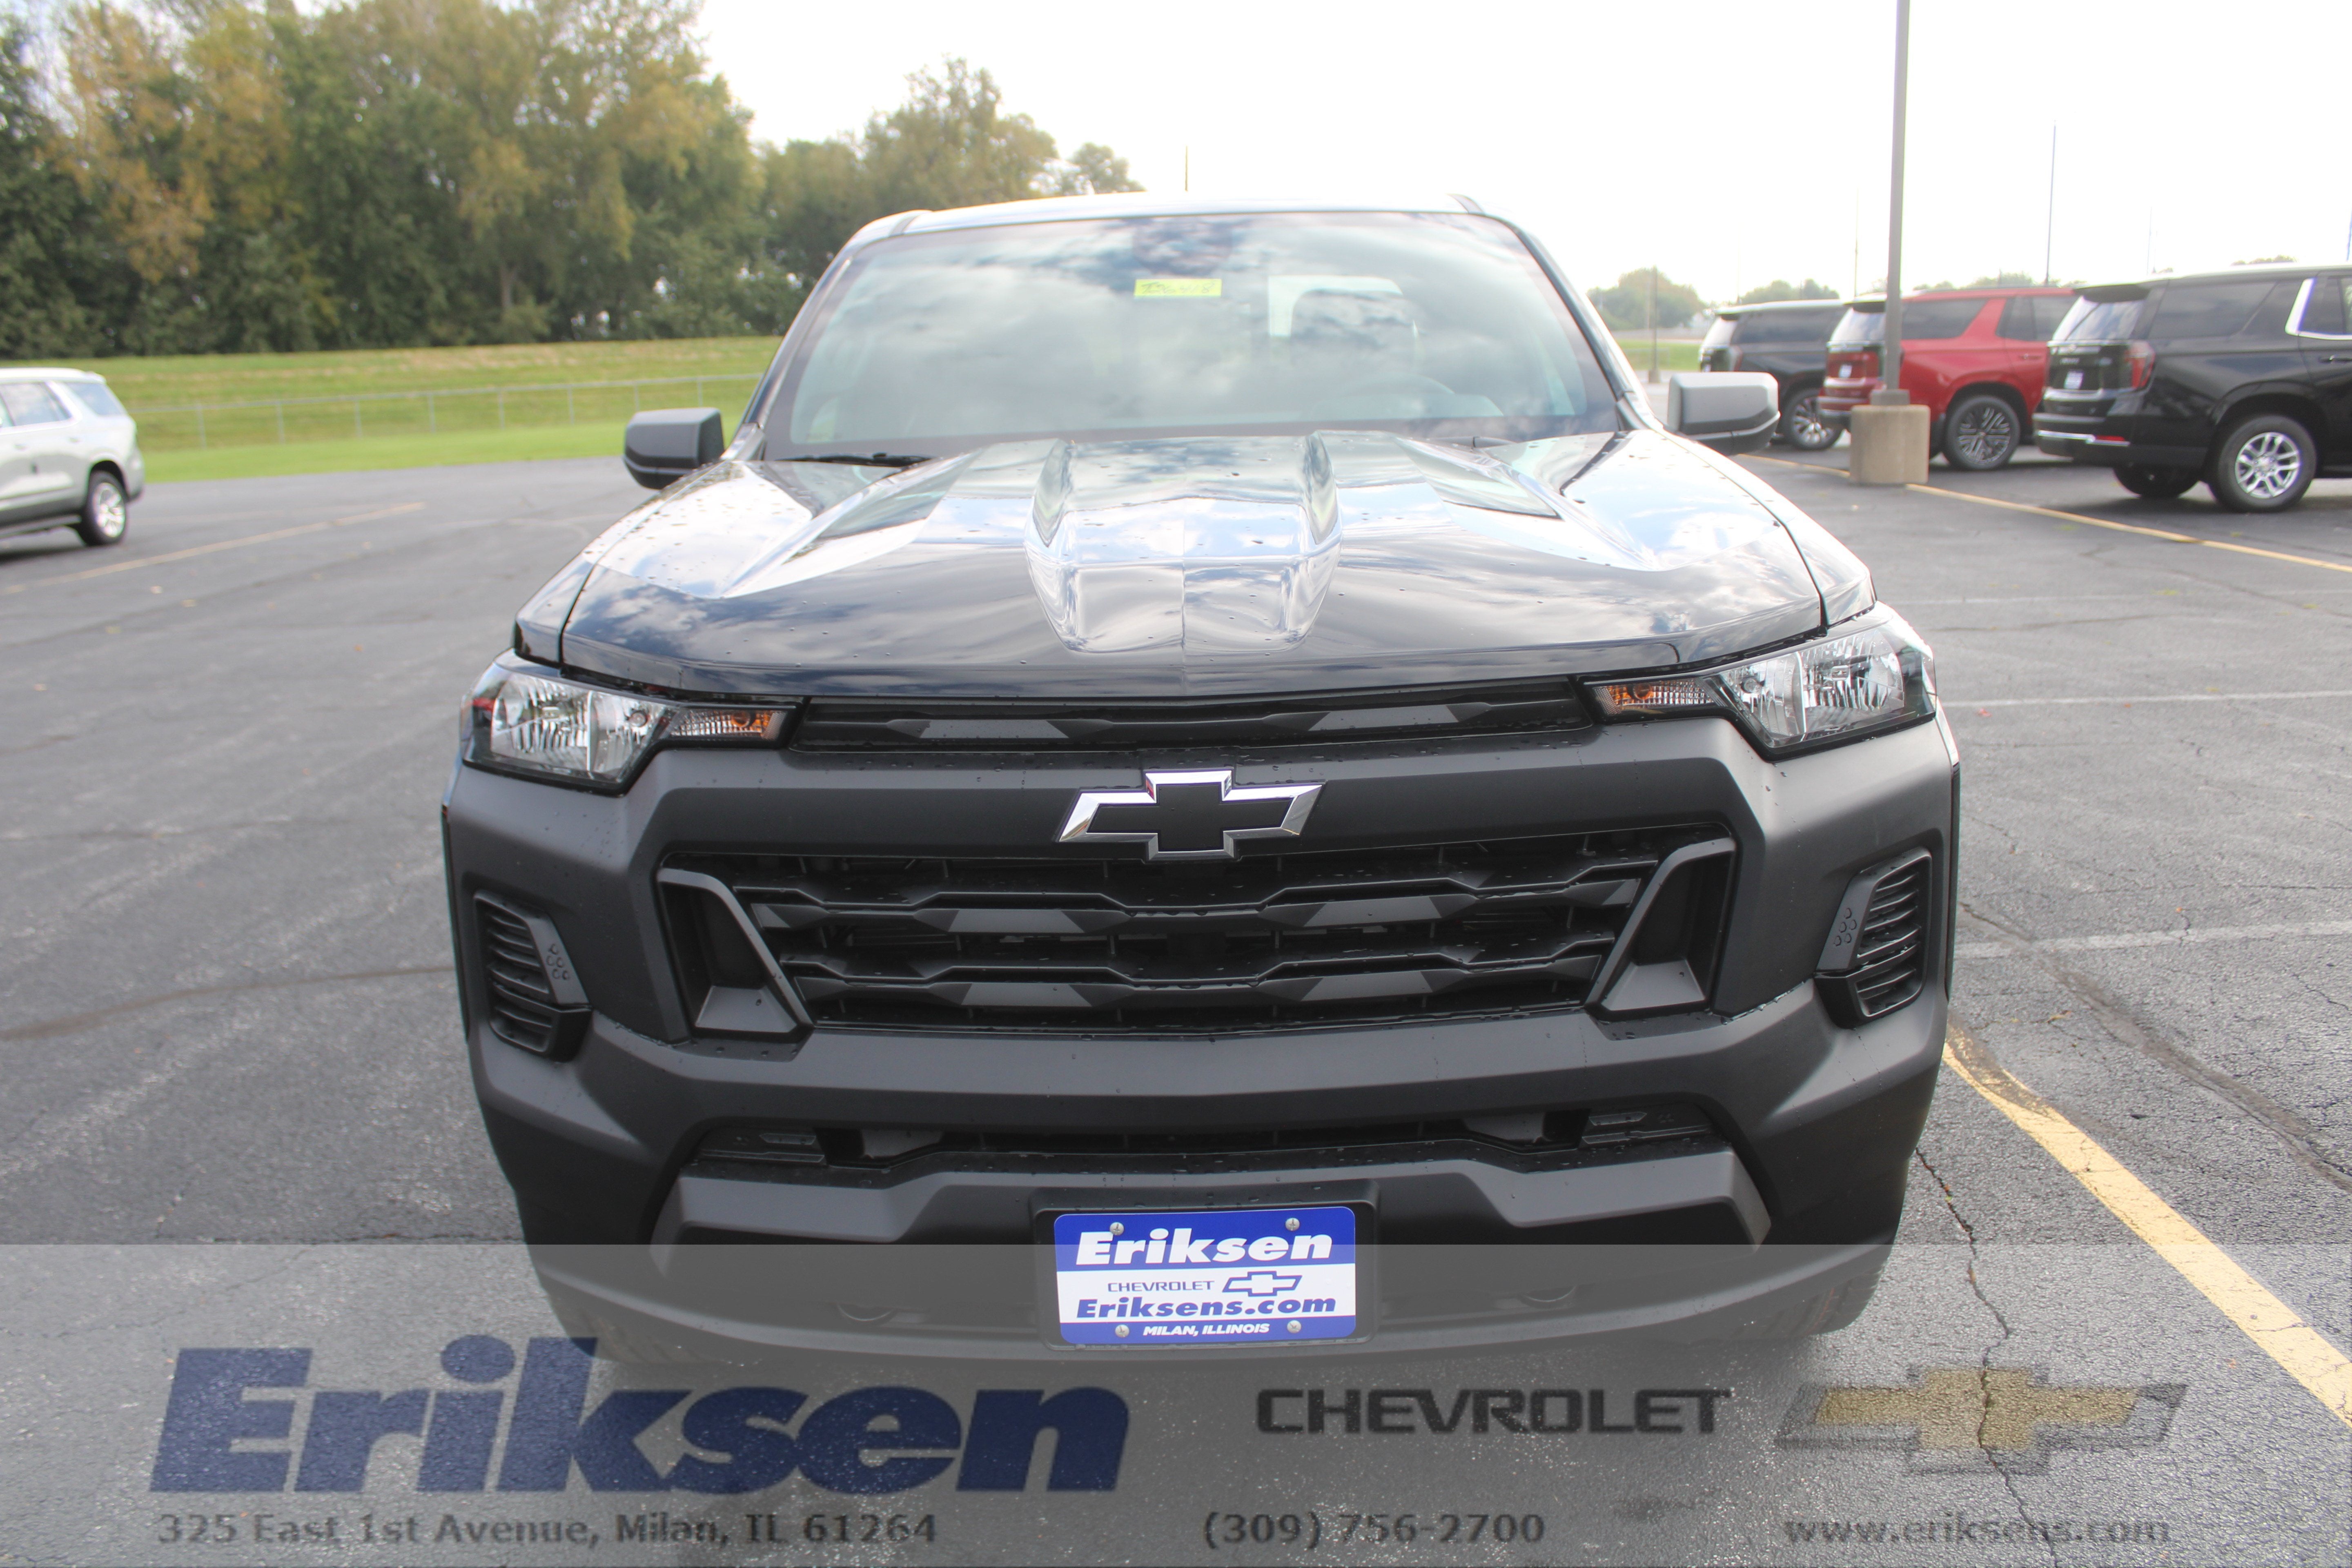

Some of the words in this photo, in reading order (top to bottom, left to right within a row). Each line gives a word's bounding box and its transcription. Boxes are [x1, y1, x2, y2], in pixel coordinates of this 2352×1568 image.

[1076, 1228, 1332, 1265] Eriksen
[1108, 1281, 1215, 1292] CHEVROLET
[1077, 1297, 1336, 1318] Eriksens.com
[1143, 1325, 1198, 1336] MILAN,
[1202, 1323, 1270, 1334] ILLINOIS
